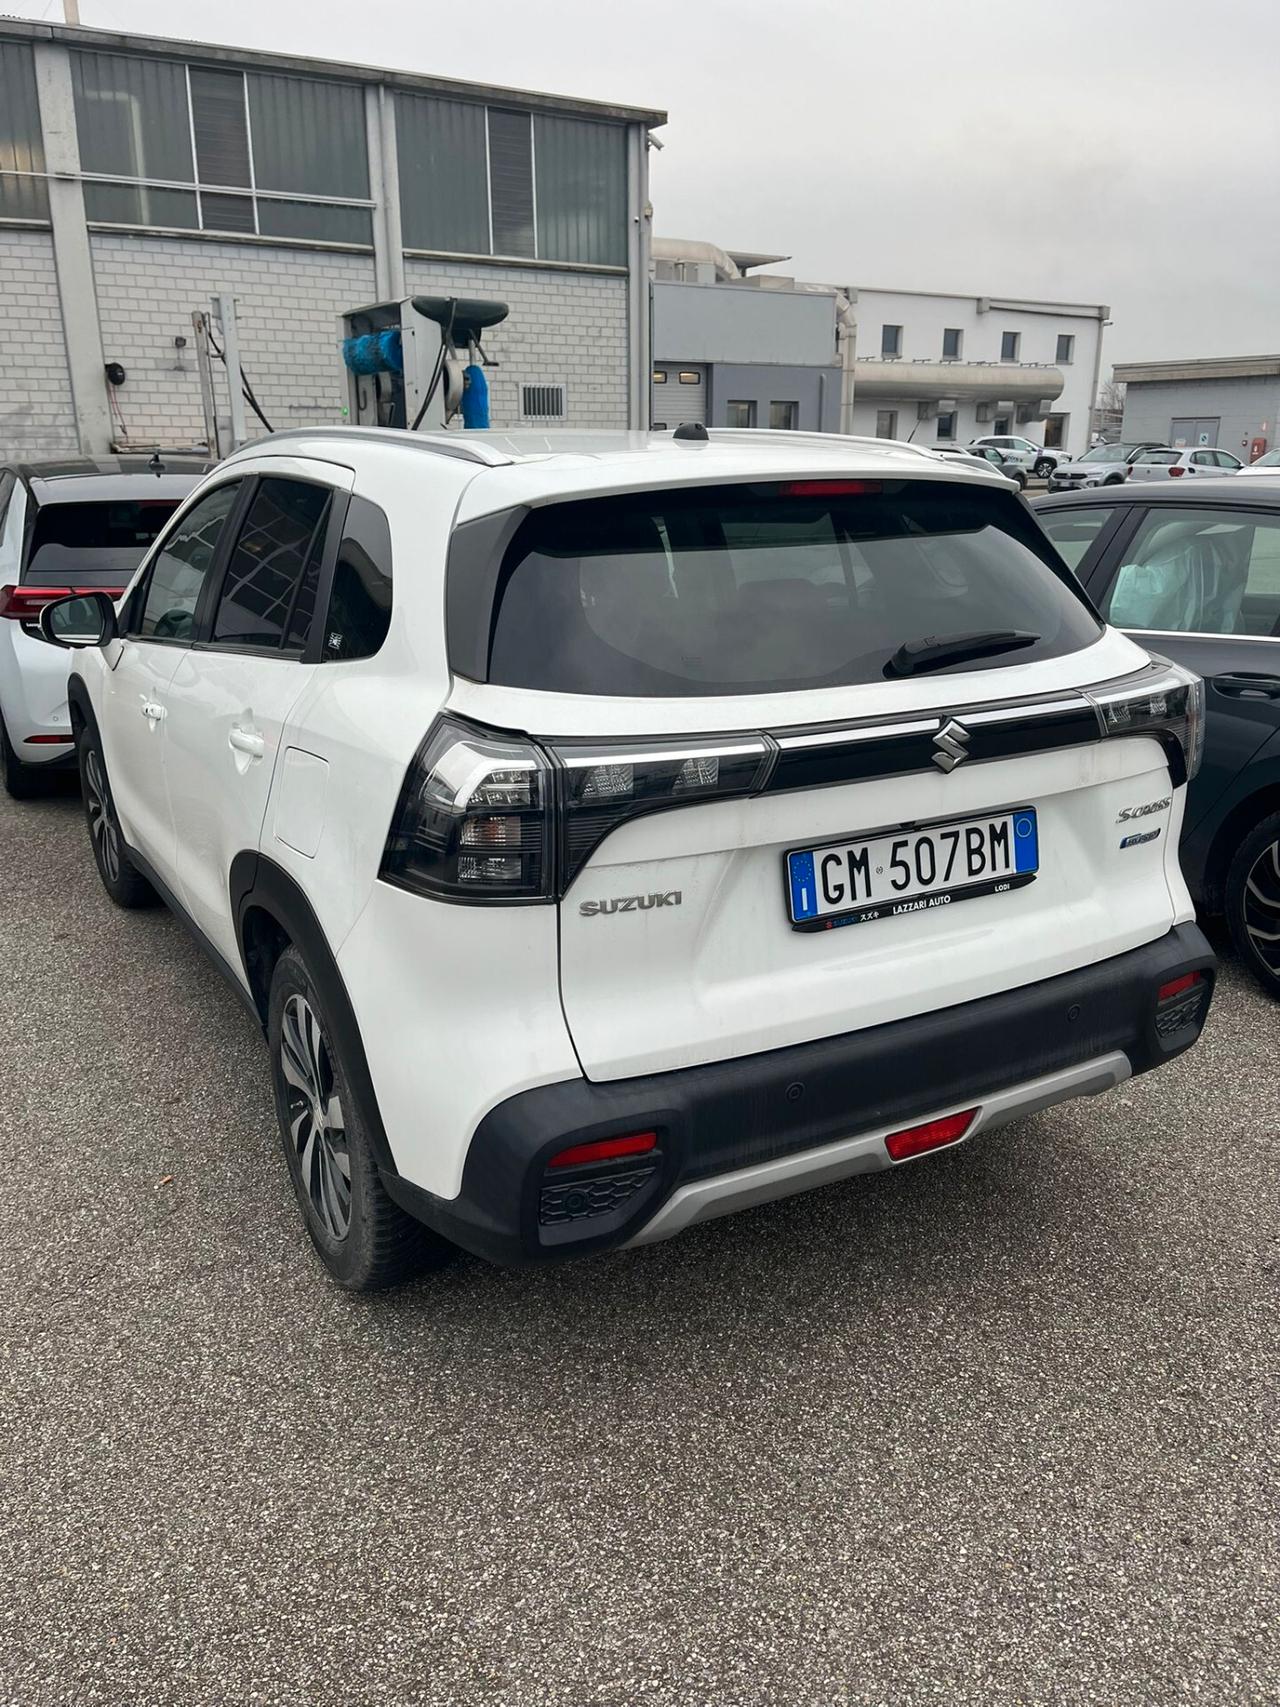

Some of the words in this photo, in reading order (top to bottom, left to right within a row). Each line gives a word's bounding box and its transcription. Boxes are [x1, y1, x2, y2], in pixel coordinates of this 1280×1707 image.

[821, 847, 873, 905] GM
[889, 821, 1010, 891] 507BM
[994, 882, 1011, 893] LODI
[579, 890, 683, 917] SUZUKI
[892, 899, 928, 916] LAZZARI
[928, 894, 951, 908] AUTO
